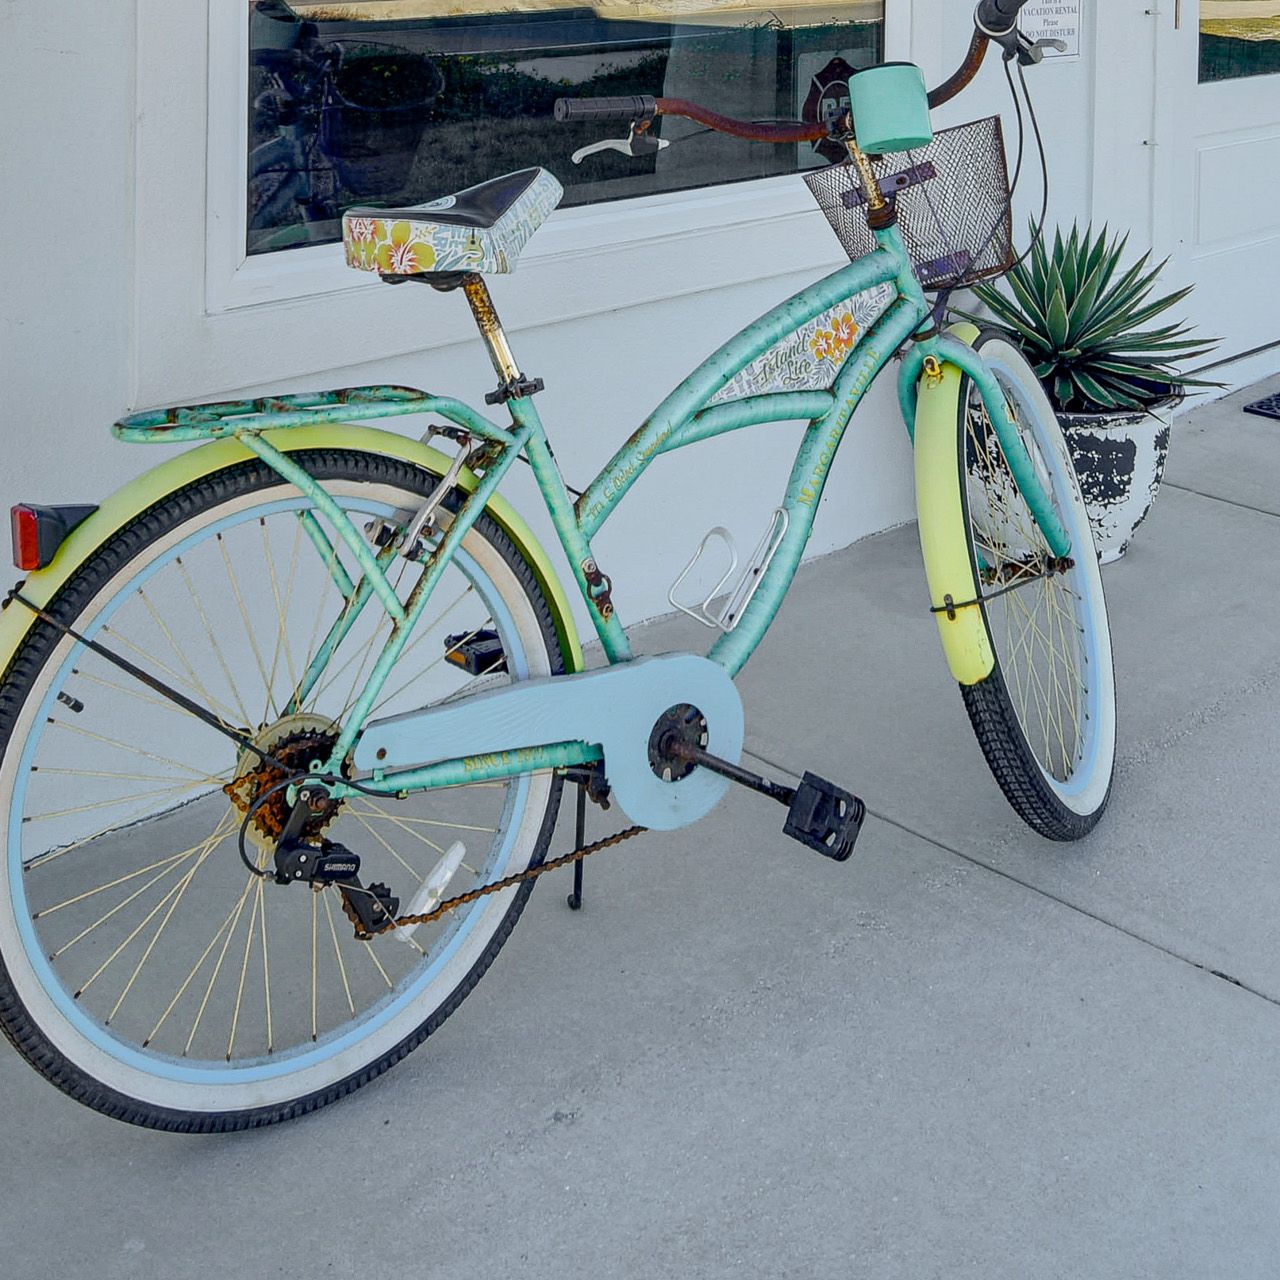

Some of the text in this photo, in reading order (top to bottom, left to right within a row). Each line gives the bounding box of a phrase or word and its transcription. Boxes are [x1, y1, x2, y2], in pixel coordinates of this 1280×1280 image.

[1023, 6, 1078, 17] VACATION RENTAL
[1043, 19, 1059, 27] Please
[1026, 28, 1075, 38] DO NOT DISTURB
[753, 332, 811, 388] Island
[783, 359, 813, 386] Life
[464, 751, 511, 772] SINCE
[323, 863, 357, 872] SHIMANO
